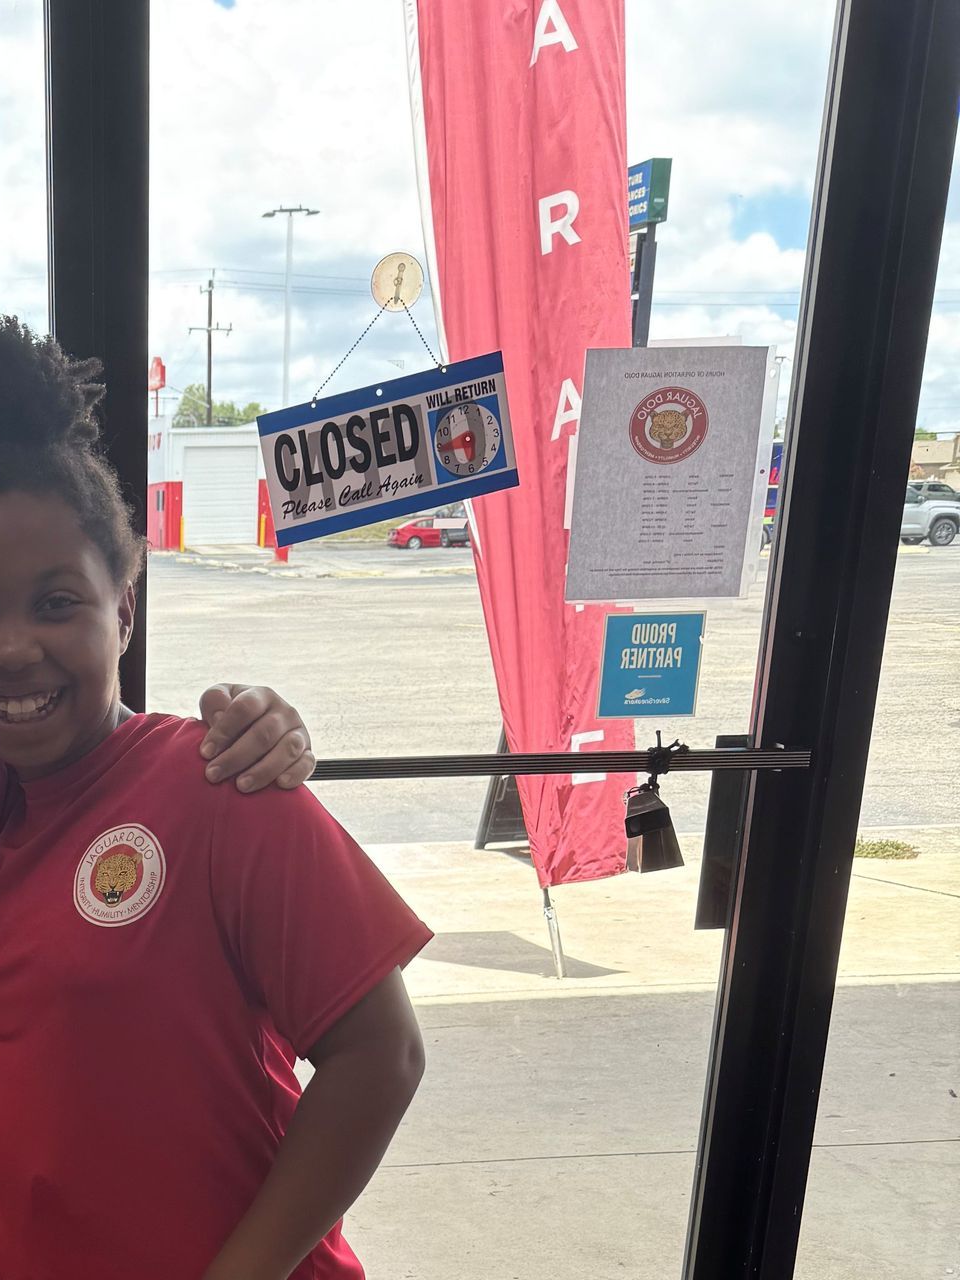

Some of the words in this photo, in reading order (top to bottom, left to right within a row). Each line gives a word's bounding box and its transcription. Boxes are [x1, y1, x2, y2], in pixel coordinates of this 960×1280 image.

[426, 391, 452, 409] WILL
[454, 378, 497, 402] RETURN
[458, 404, 470, 416] 12
[475, 407, 481, 417] 1
[446, 415, 456, 425] 11
[486, 415, 493, 425] 2
[438, 427, 449, 438] 10
[492, 428, 500, 438] 3
[274, 403, 420, 492] CLOSED
[490, 443, 496, 452] 4
[444, 455, 451, 465] 8
[482, 456, 489, 466] 5
[454, 464, 460, 473] 7
[468, 464, 475, 473] 6
[281, 496, 333, 519] Please
[338, 482, 373, 507] Call
[376, 472, 425, 496] Again
[85, 831, 126, 868] JAGUAR
[125, 831, 154, 860] DOJO
[79, 876, 93, 910] INTEGRITY
[91, 906, 125, 919] HUMILITY
[127, 871, 158, 915] MENTORSHIP
